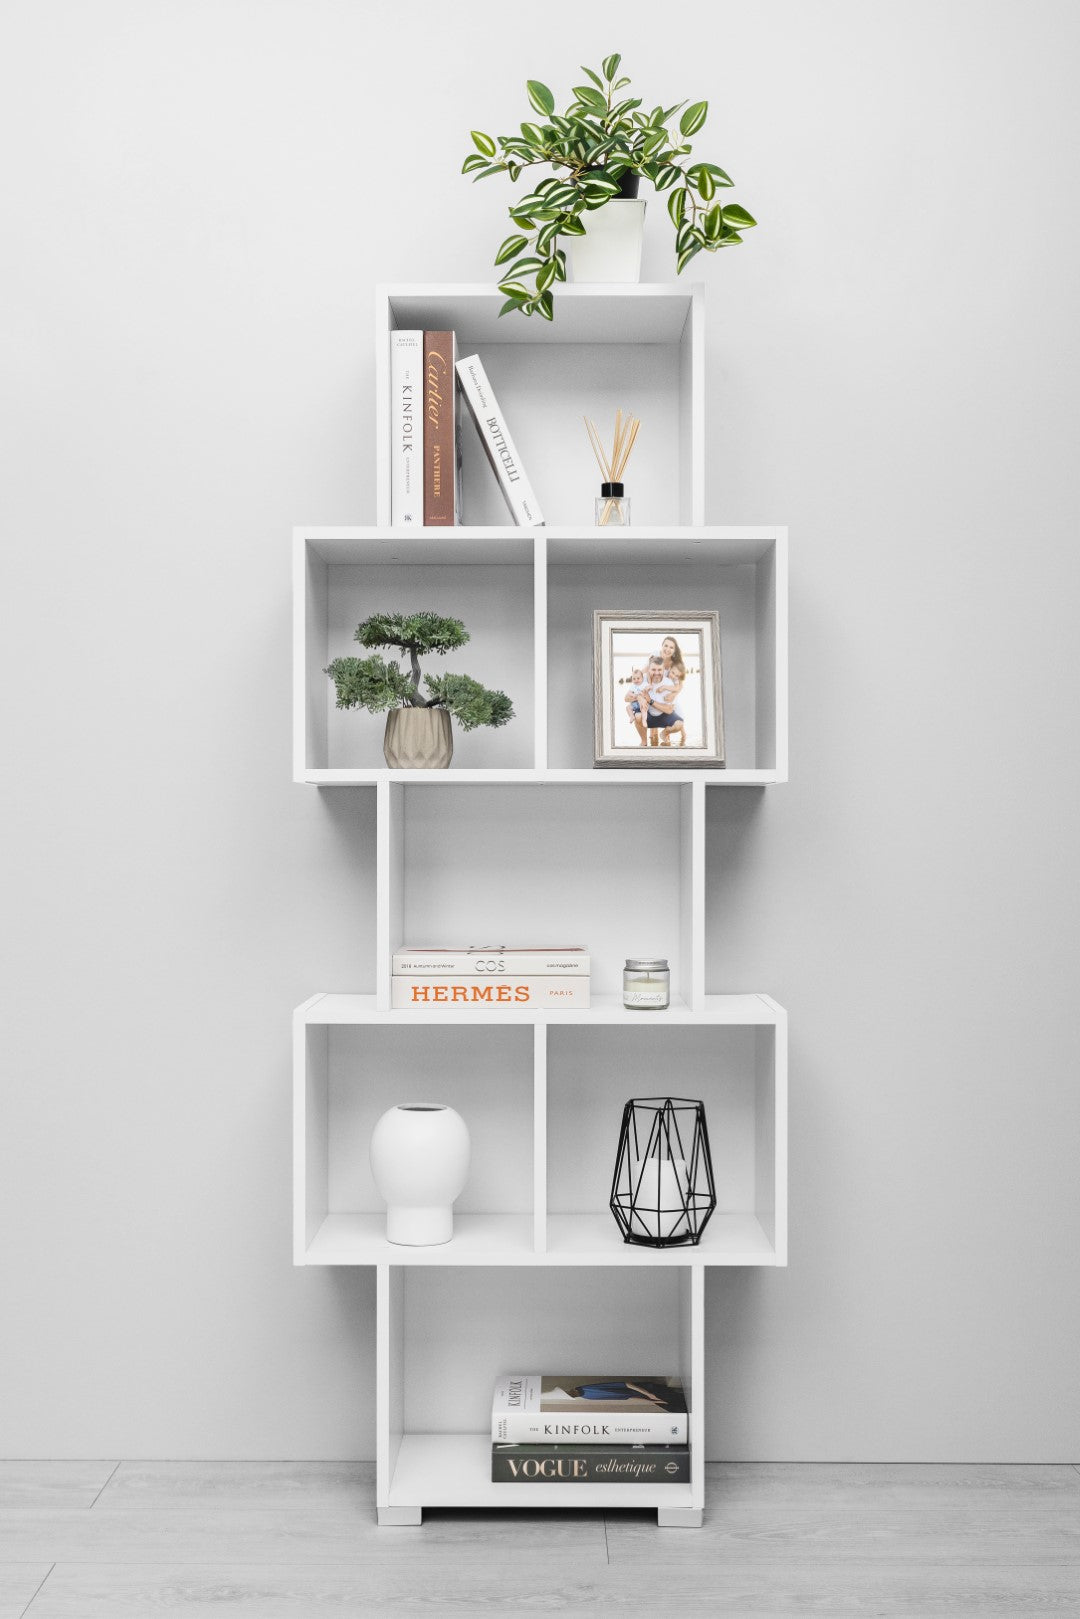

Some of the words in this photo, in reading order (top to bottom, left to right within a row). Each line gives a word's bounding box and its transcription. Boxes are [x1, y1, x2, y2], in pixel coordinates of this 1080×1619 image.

[428, 351, 447, 430] Cartier
[402, 385, 413, 453] KINFOLK
[486, 417, 520, 483] BOTTICELLI
[433, 445, 441, 498] PANTHERE
[475, 960, 506, 972] COS
[508, 1380, 522, 1407] KINFOLK
[544, 1424, 610, 1436] KINFOLK
[507, 1460, 588, 1477] VOGUE
